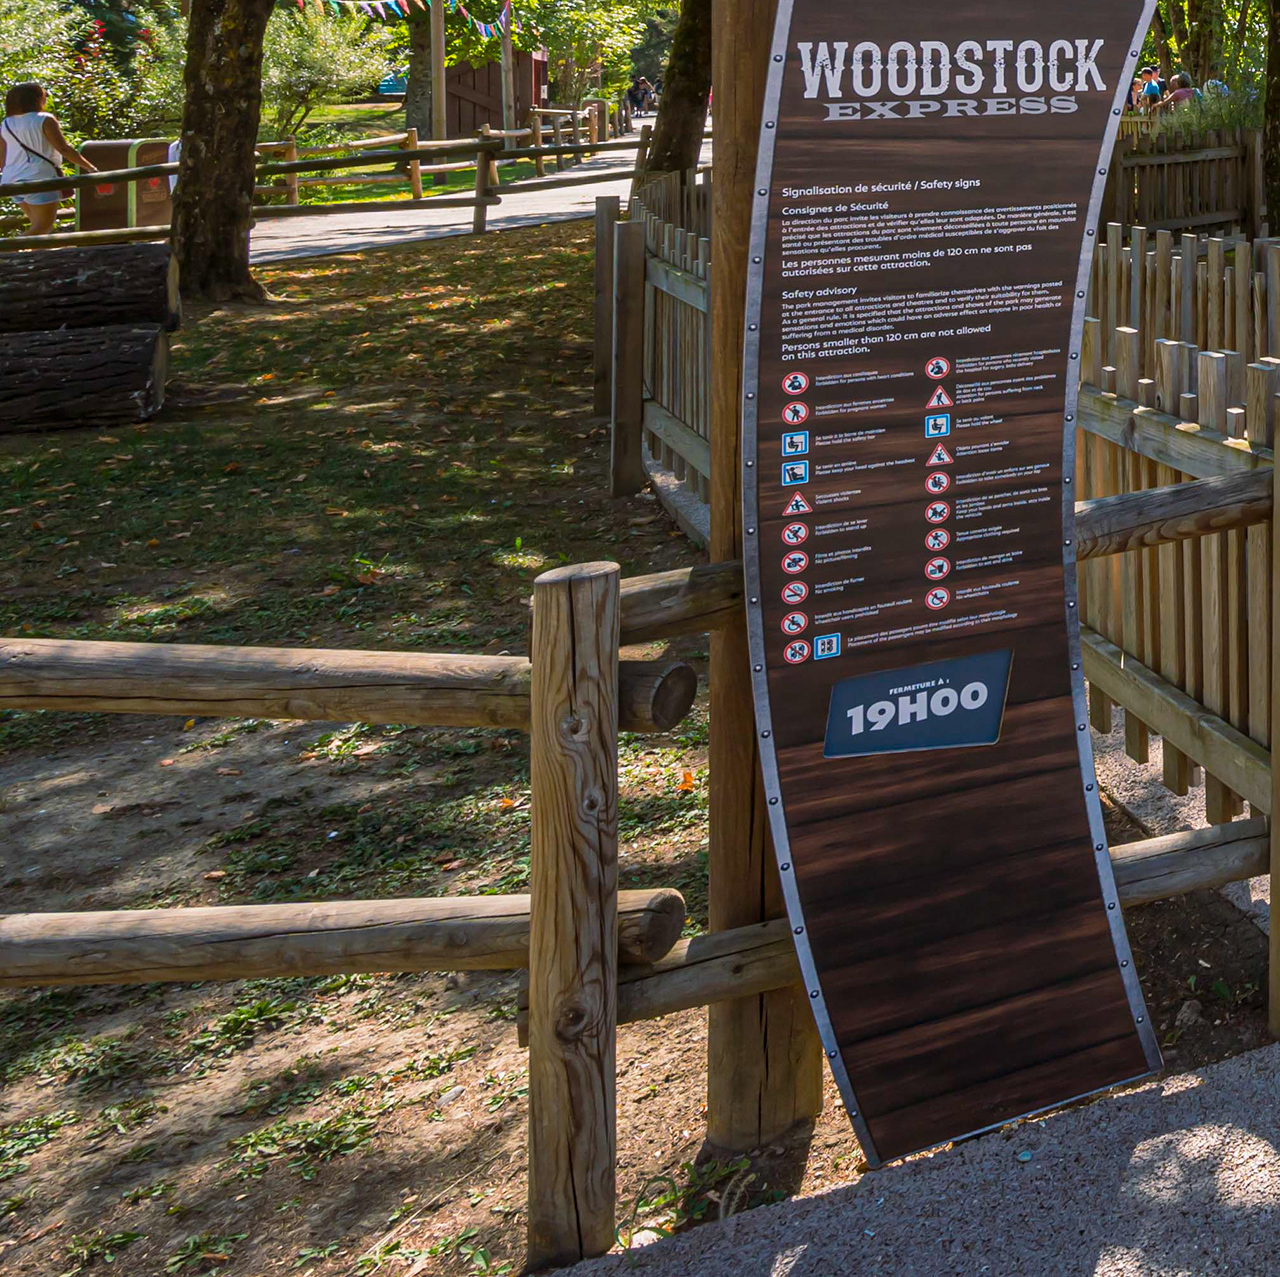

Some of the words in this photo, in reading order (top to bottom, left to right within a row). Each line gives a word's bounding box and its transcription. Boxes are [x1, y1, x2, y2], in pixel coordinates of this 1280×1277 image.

[796, 38, 1108, 100] WOODSTOCK
[822, 95, 1080, 121] EXPRESS
[782, 185, 852, 198] Signalisation
[855, 184, 868, 193] de
[871, 182, 912, 192] sécurité
[921, 180, 953, 190] Safety
[955, 179, 980, 189] signs
[782, 206, 833, 215] Consignes
[835, 204, 848, 212] de
[850, 202, 889, 211] Sécurité
[801, 258, 851, 269] personnes
[854, 253, 900, 263] mesurant
[902, 251, 931, 259] moins
[948, 248, 963, 256] 120
[994, 244, 1014, 253] sont
[1016, 245, 1032, 253] pas
[782, 267, 834, 277] autorisées
[853, 263, 878, 271] cette
[880, 260, 931, 269] attraction.
[782, 290, 814, 299] Safety
[816, 288, 857, 296] advisory
[782, 343, 820, 351] Persons
[823, 338, 858, 347] smaller
[861, 336, 884, 344] than
[886, 333, 902, 341] 120
[938, 328, 954, 336] not
[956, 324, 991, 335] allowed
[797, 350, 816, 359] this
[818, 346, 871, 357] attraction.
[889, 680, 936, 695] FERMETURE
[937, 677, 944, 685] À
[847, 681, 988, 736] 19H00
